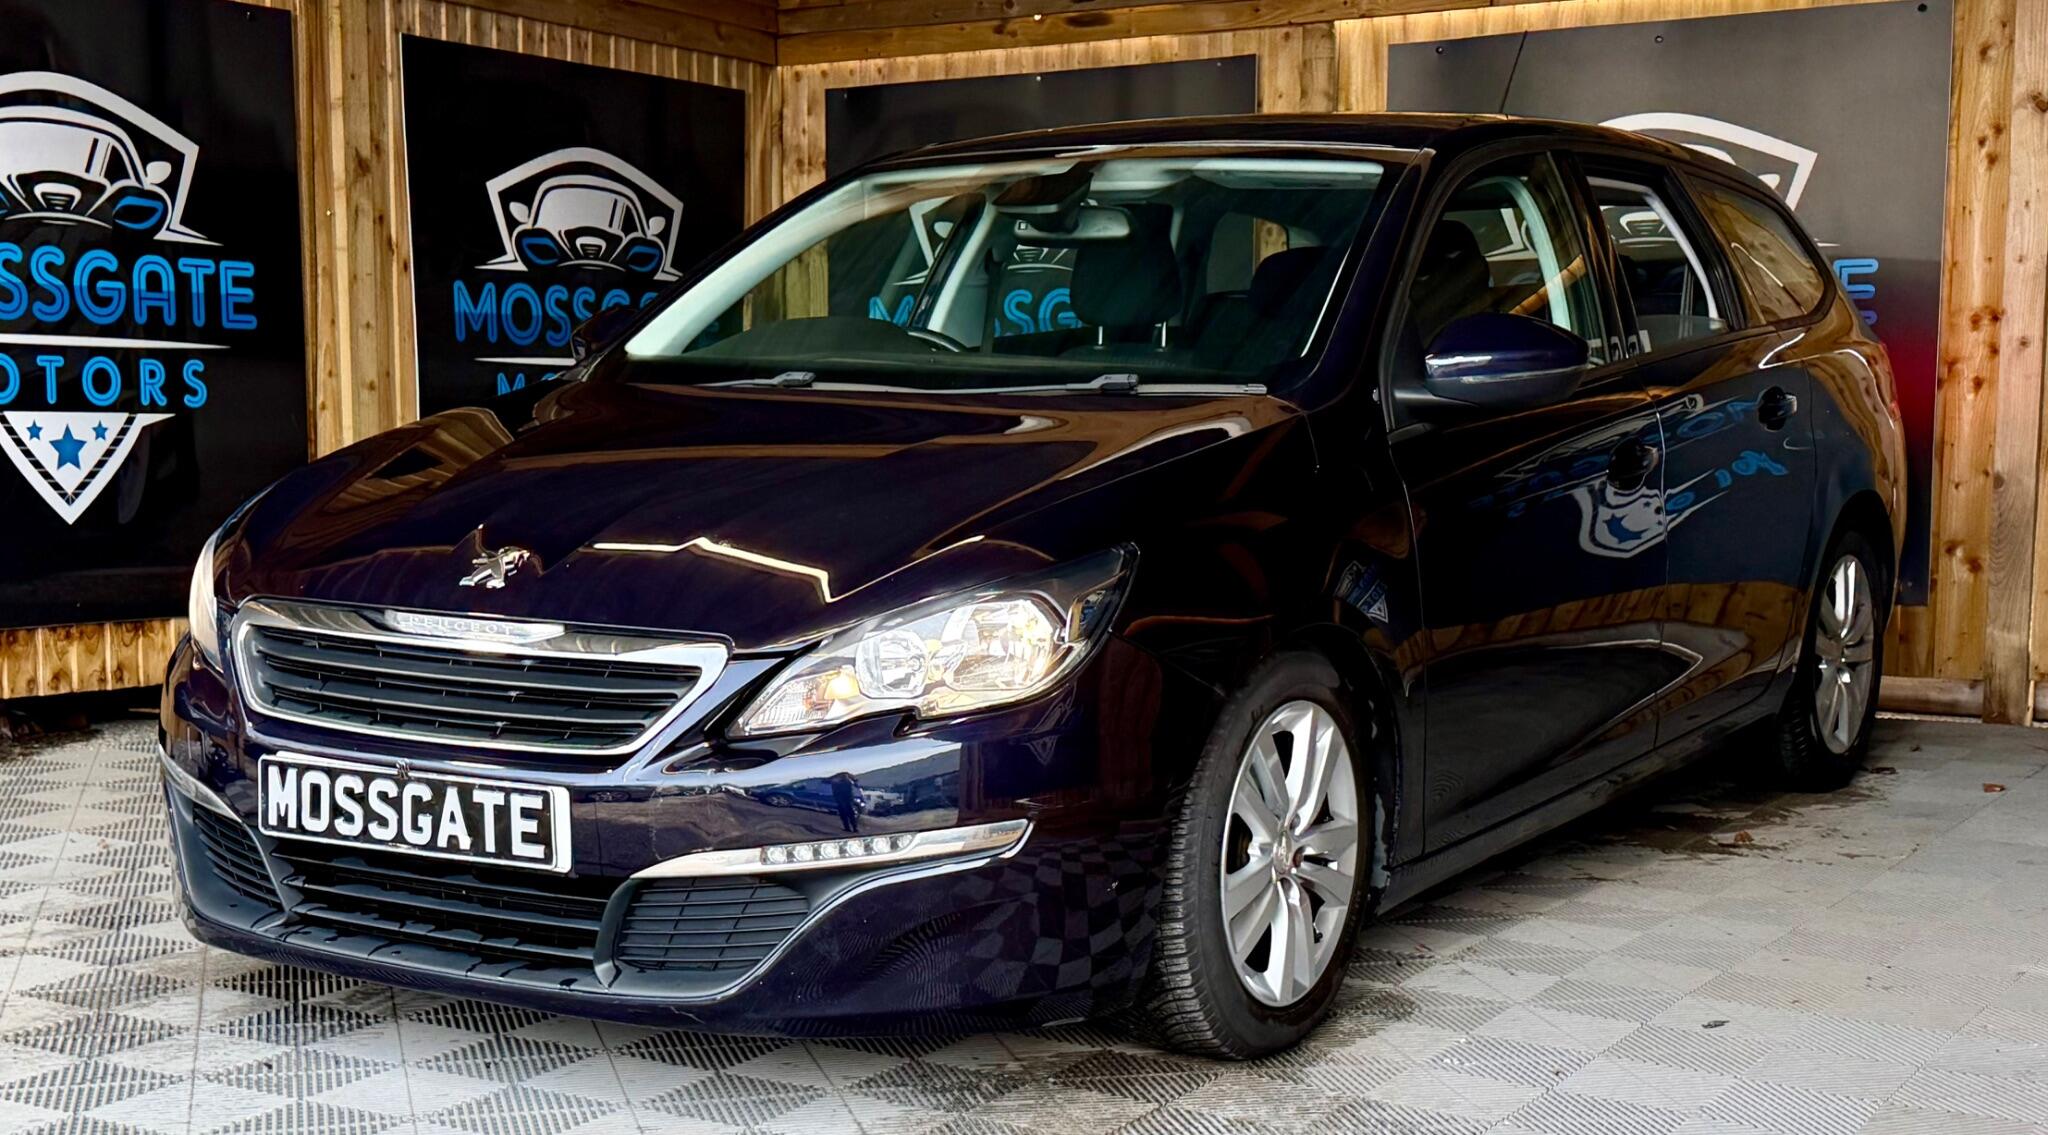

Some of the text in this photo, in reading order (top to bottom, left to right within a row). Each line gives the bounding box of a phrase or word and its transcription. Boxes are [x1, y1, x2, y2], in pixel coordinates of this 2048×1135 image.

[453, 279, 658, 348] MOSS
[409, 615, 515, 635] PEUGEOT
[267, 765, 546, 859] MOSSGATE
